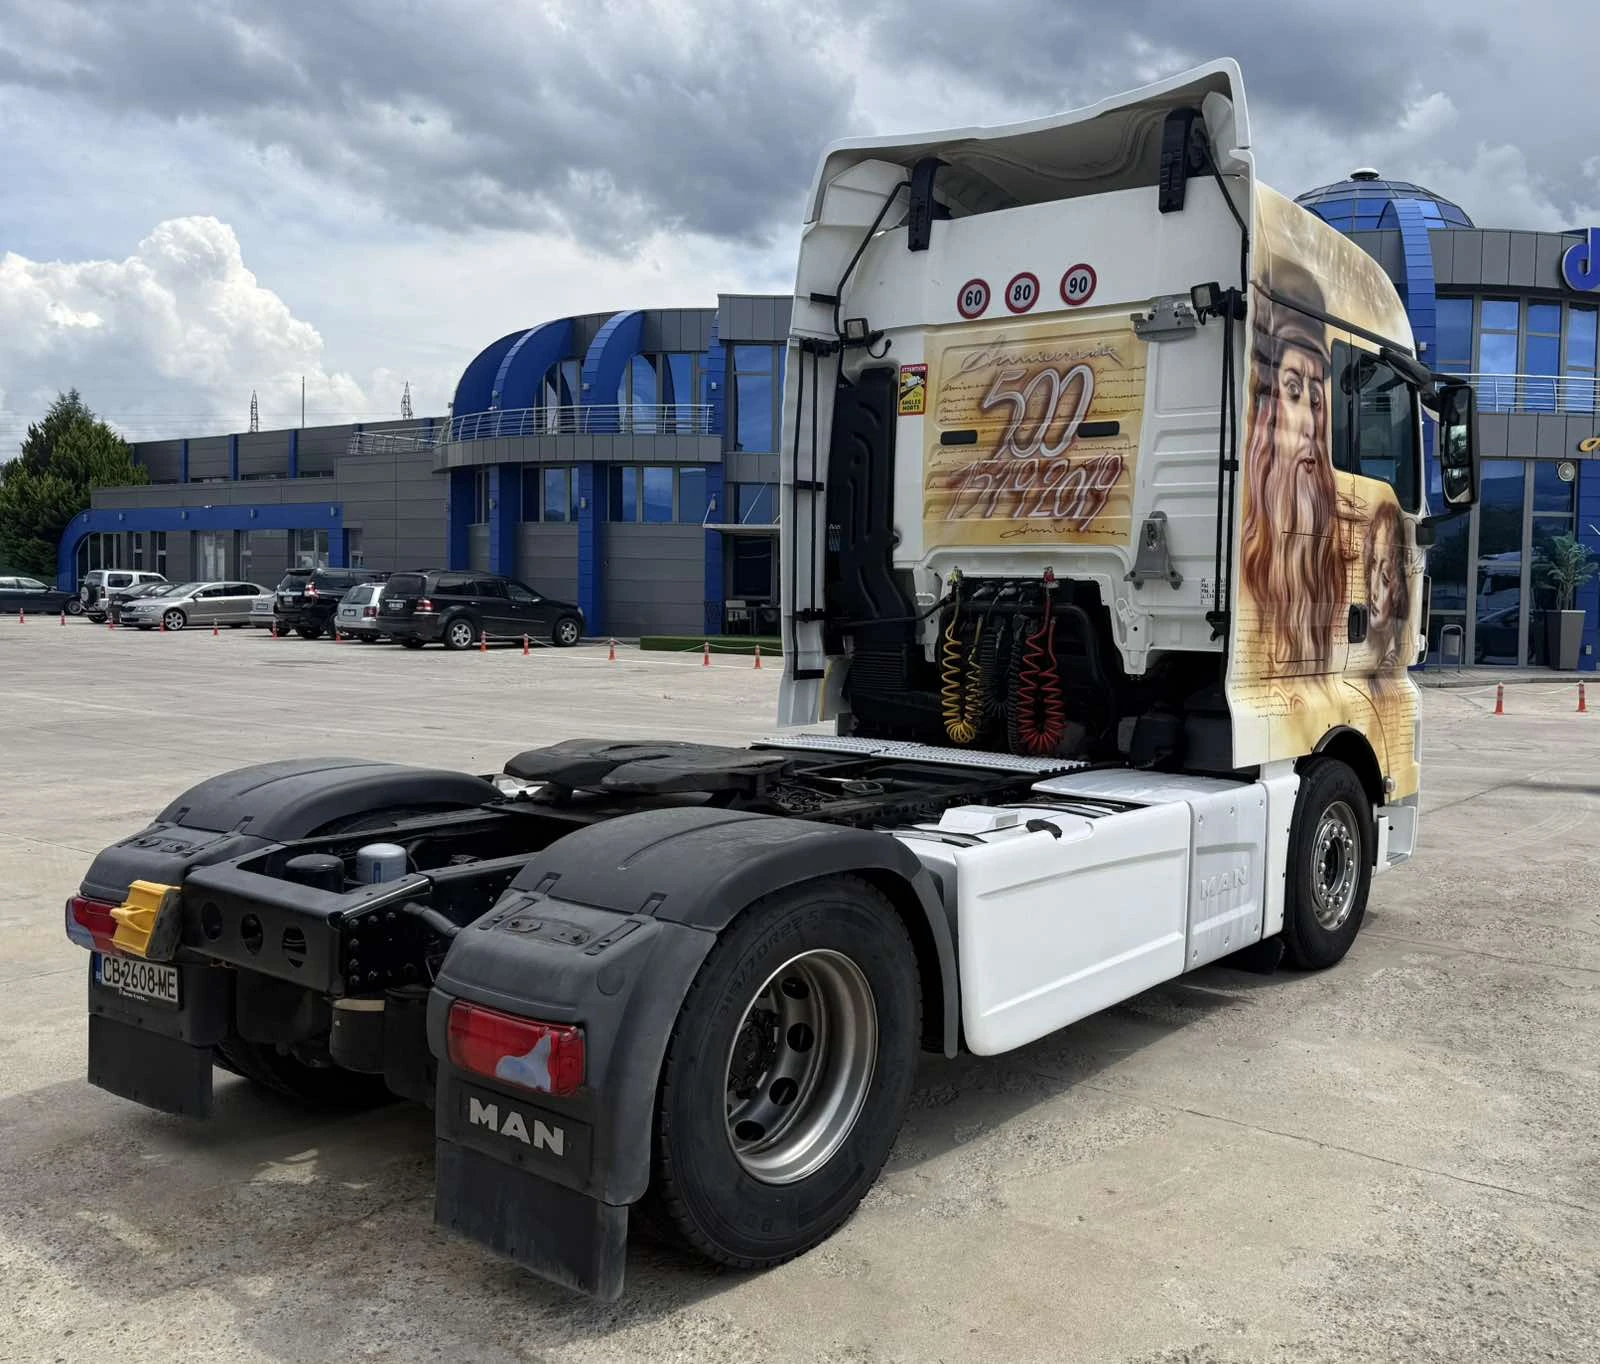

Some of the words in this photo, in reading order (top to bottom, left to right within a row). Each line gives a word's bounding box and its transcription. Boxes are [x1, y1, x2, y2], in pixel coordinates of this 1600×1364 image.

[965, 289, 982, 306] 60
[1013, 284, 1031, 301] 80
[1069, 276, 1088, 293] 90
[982, 364, 1095, 458] 500
[1201, 864, 1248, 900] MAN
[468, 1096, 565, 1157] MAN
